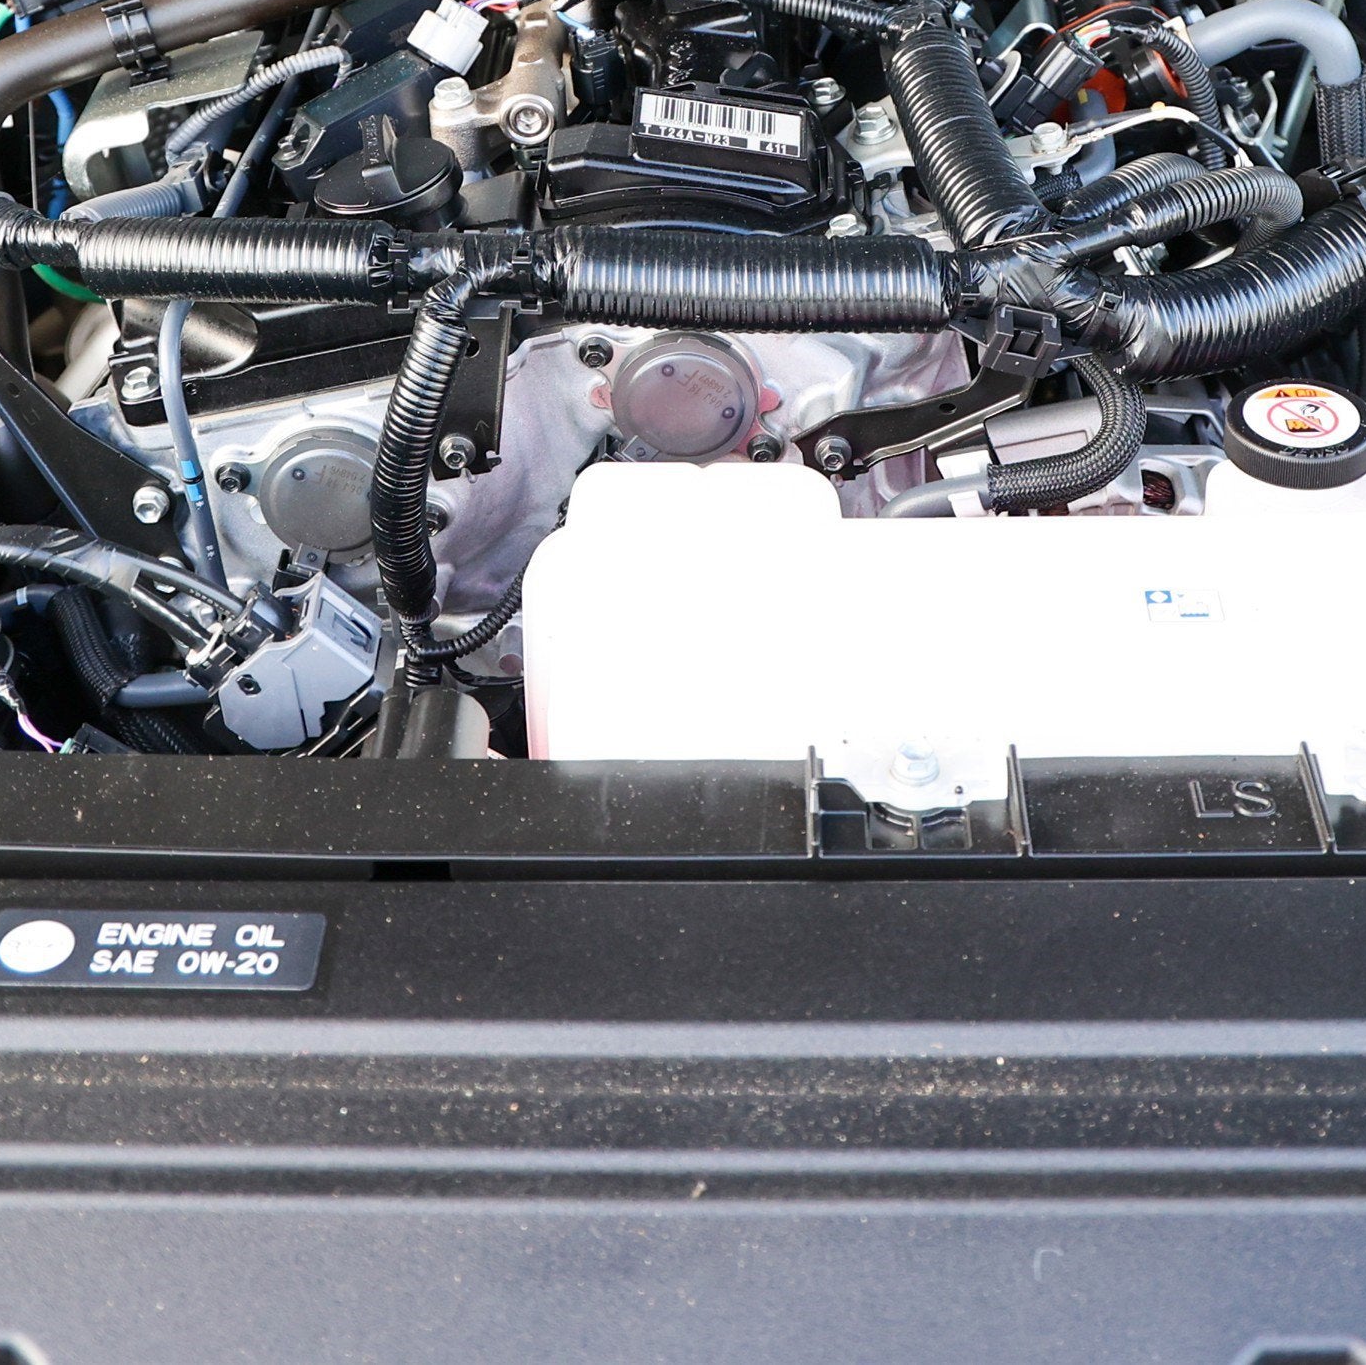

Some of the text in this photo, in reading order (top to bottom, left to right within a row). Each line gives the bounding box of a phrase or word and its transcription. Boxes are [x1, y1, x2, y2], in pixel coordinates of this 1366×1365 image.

[659, 126, 730, 147] T24A-N23
[765, 143, 786, 155] 411
[1188, 779, 1277, 819] LS
[96, 922, 286, 948] ENGINE OIL
[89, 949, 159, 974] SAE
